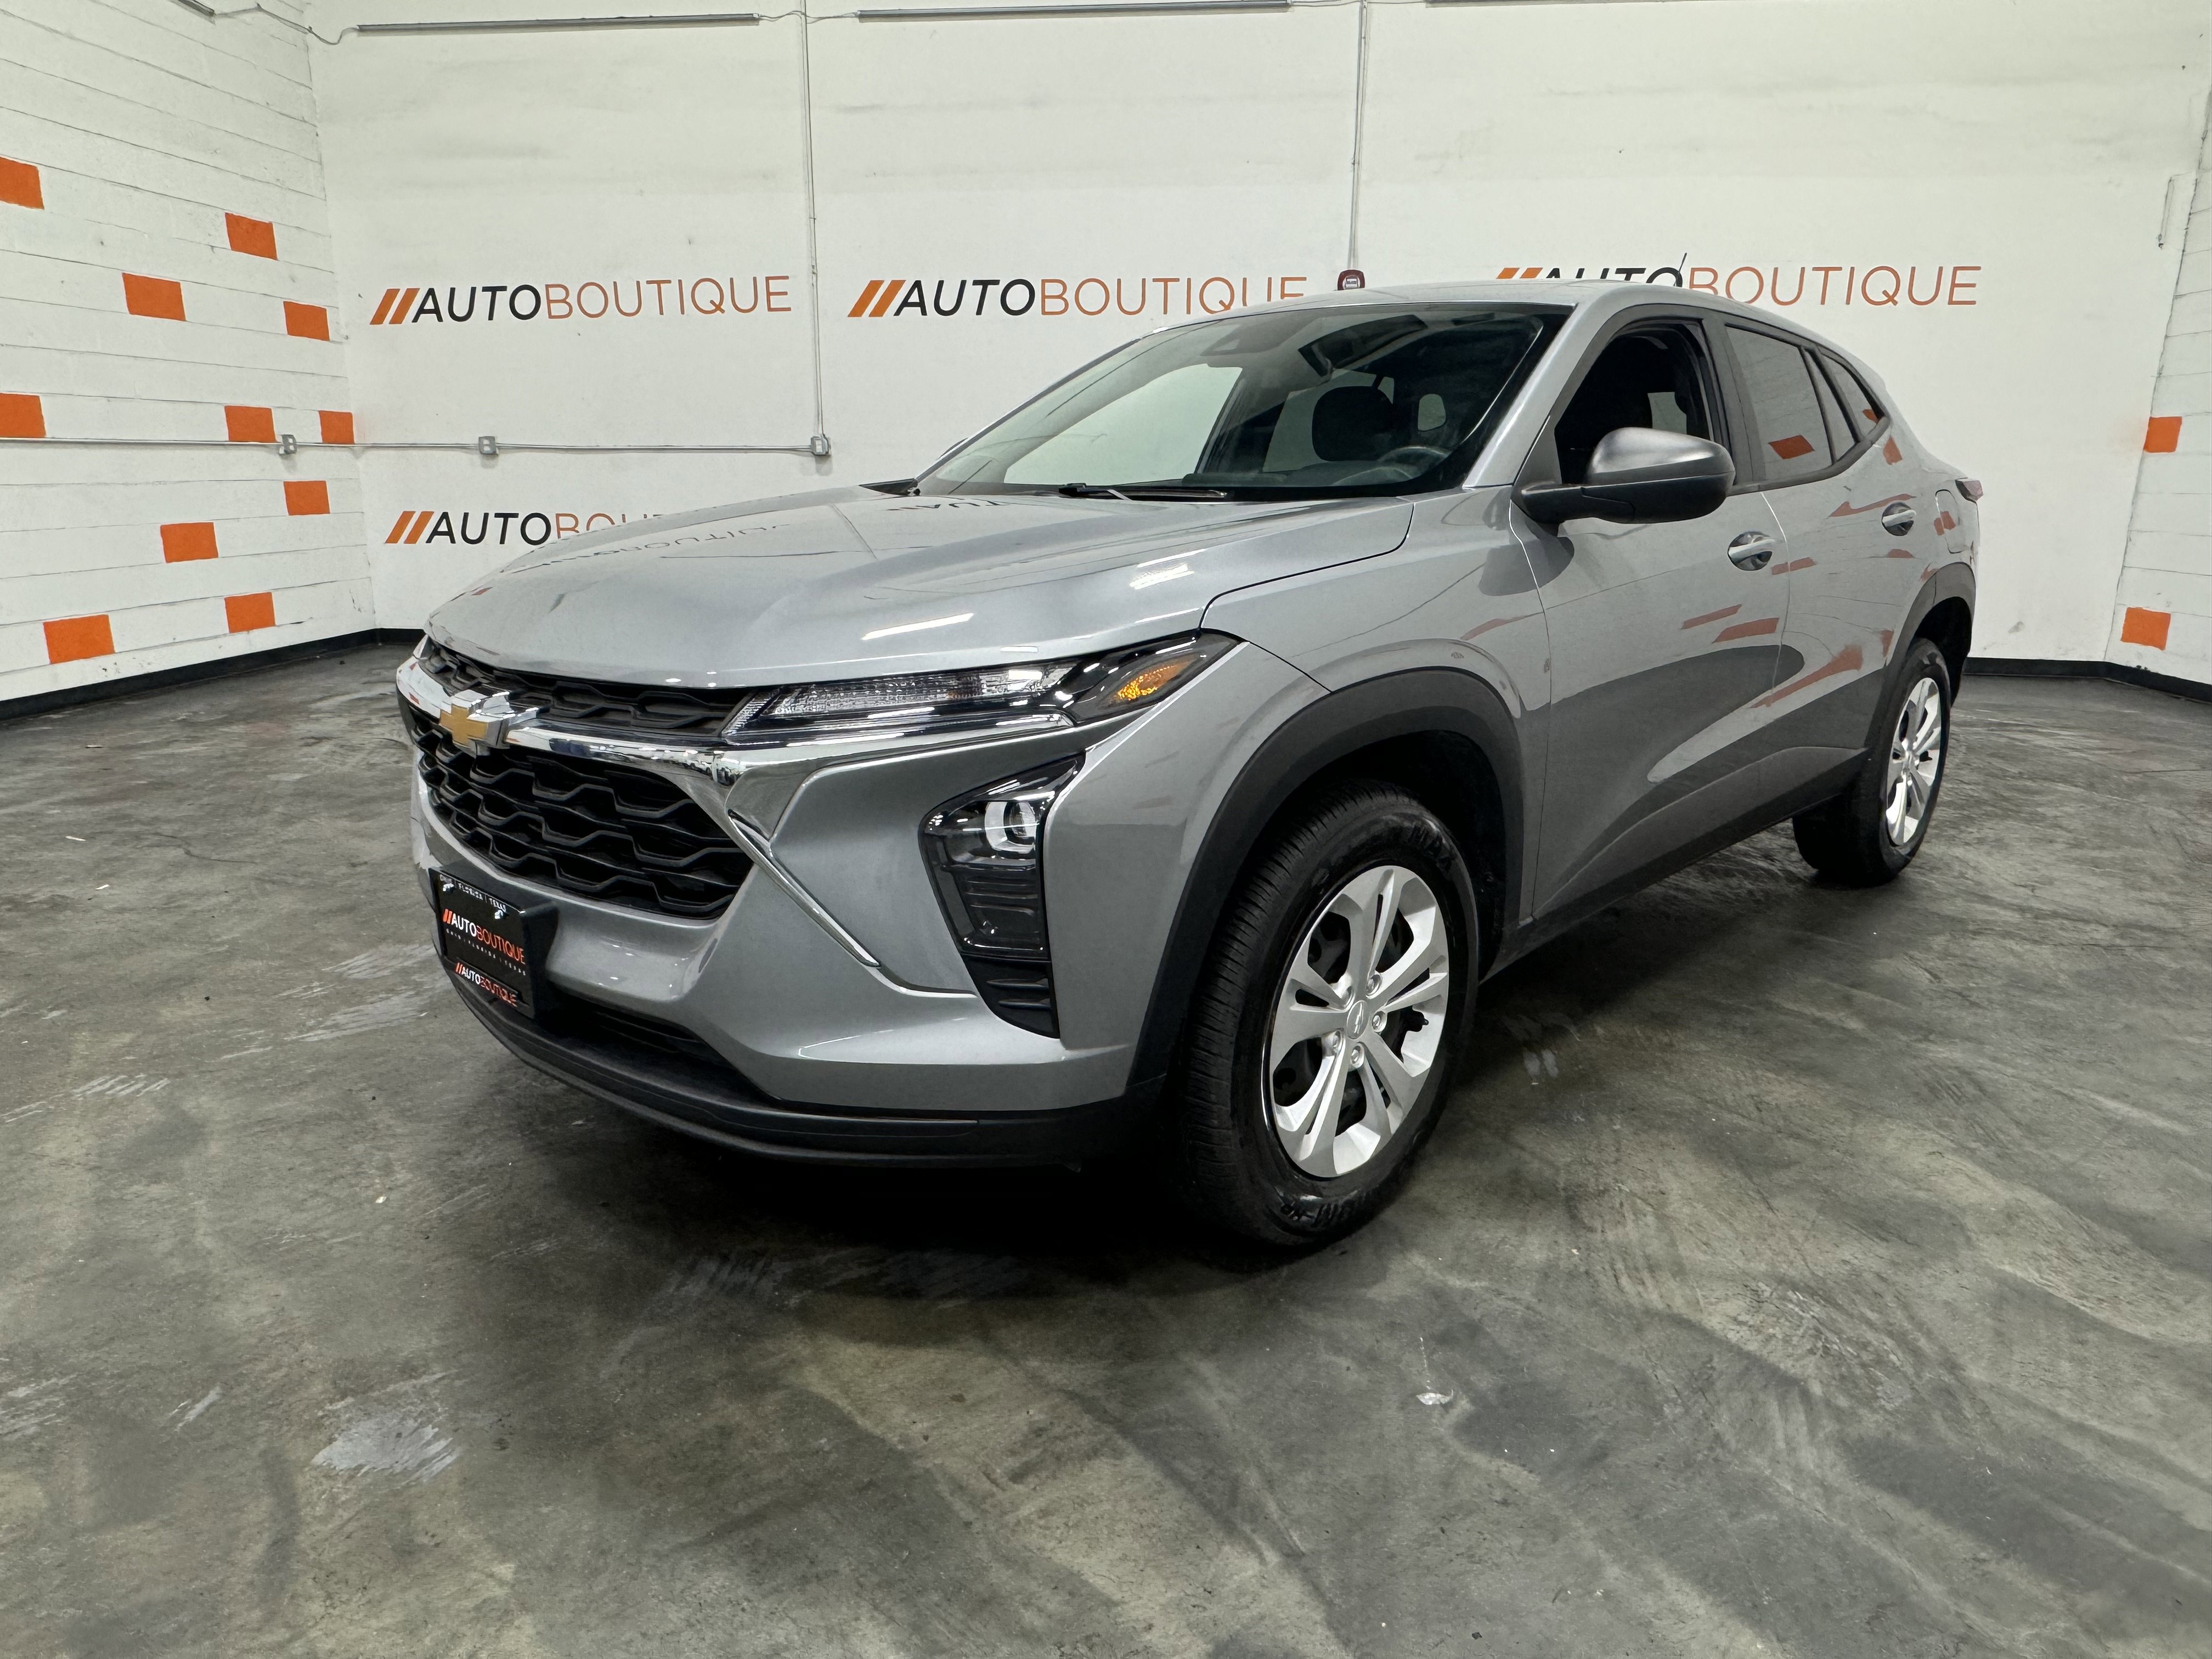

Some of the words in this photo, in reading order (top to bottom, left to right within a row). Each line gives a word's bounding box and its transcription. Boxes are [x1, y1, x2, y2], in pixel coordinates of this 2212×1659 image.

[411, 275, 792, 323] AUTOBOUTIQUE
[1545, 266, 1982, 306] BOUTIQUE
[451, 913, 526, 965] AUTOBOUTIQUE
